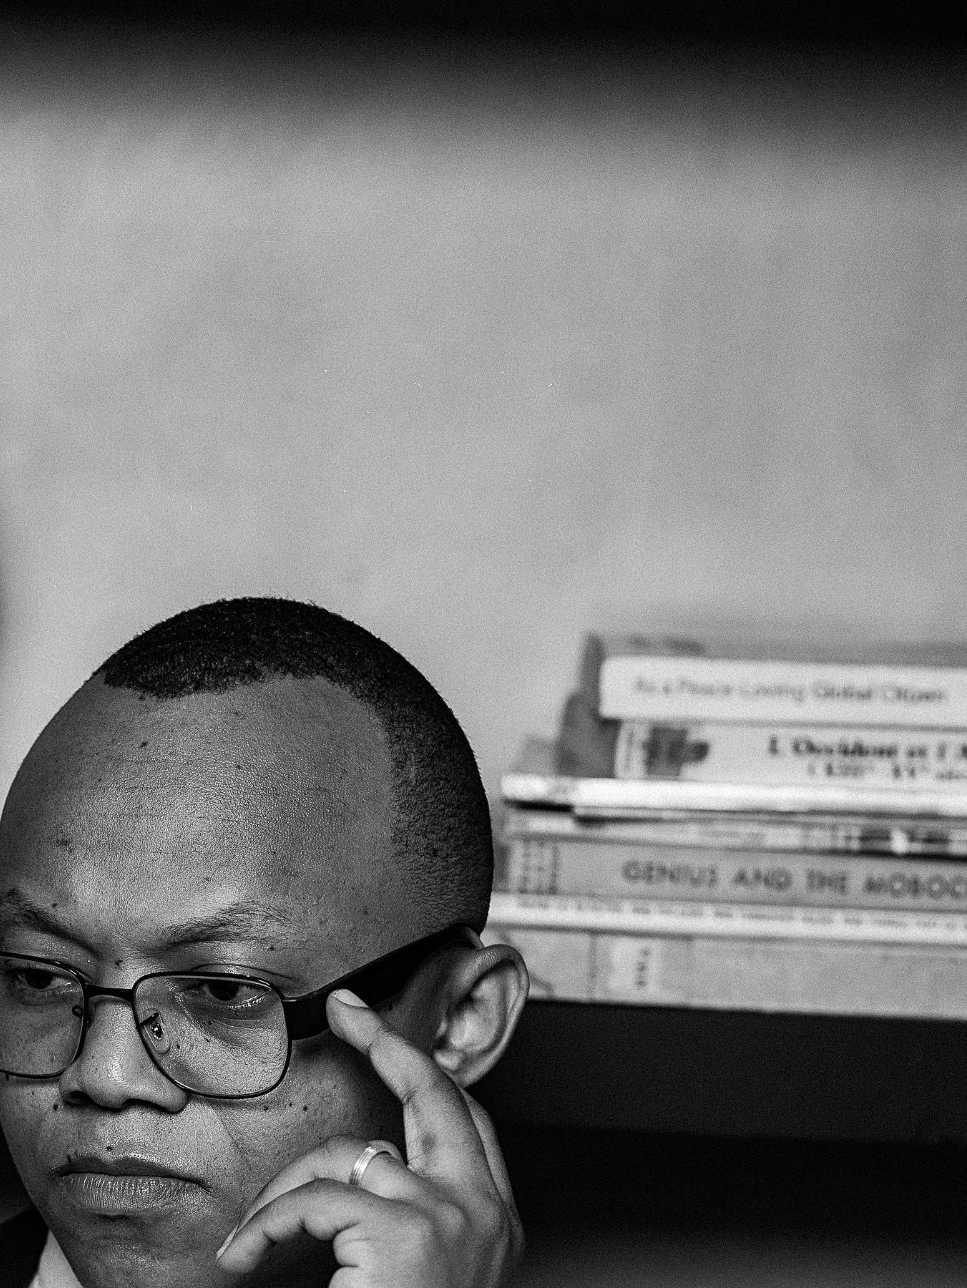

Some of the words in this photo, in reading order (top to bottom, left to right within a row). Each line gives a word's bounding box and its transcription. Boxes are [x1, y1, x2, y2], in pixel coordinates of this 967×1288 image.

[621, 861, 718, 889] GENIUS
[732, 866, 794, 892] AND
[807, 867, 848, 896] THE
